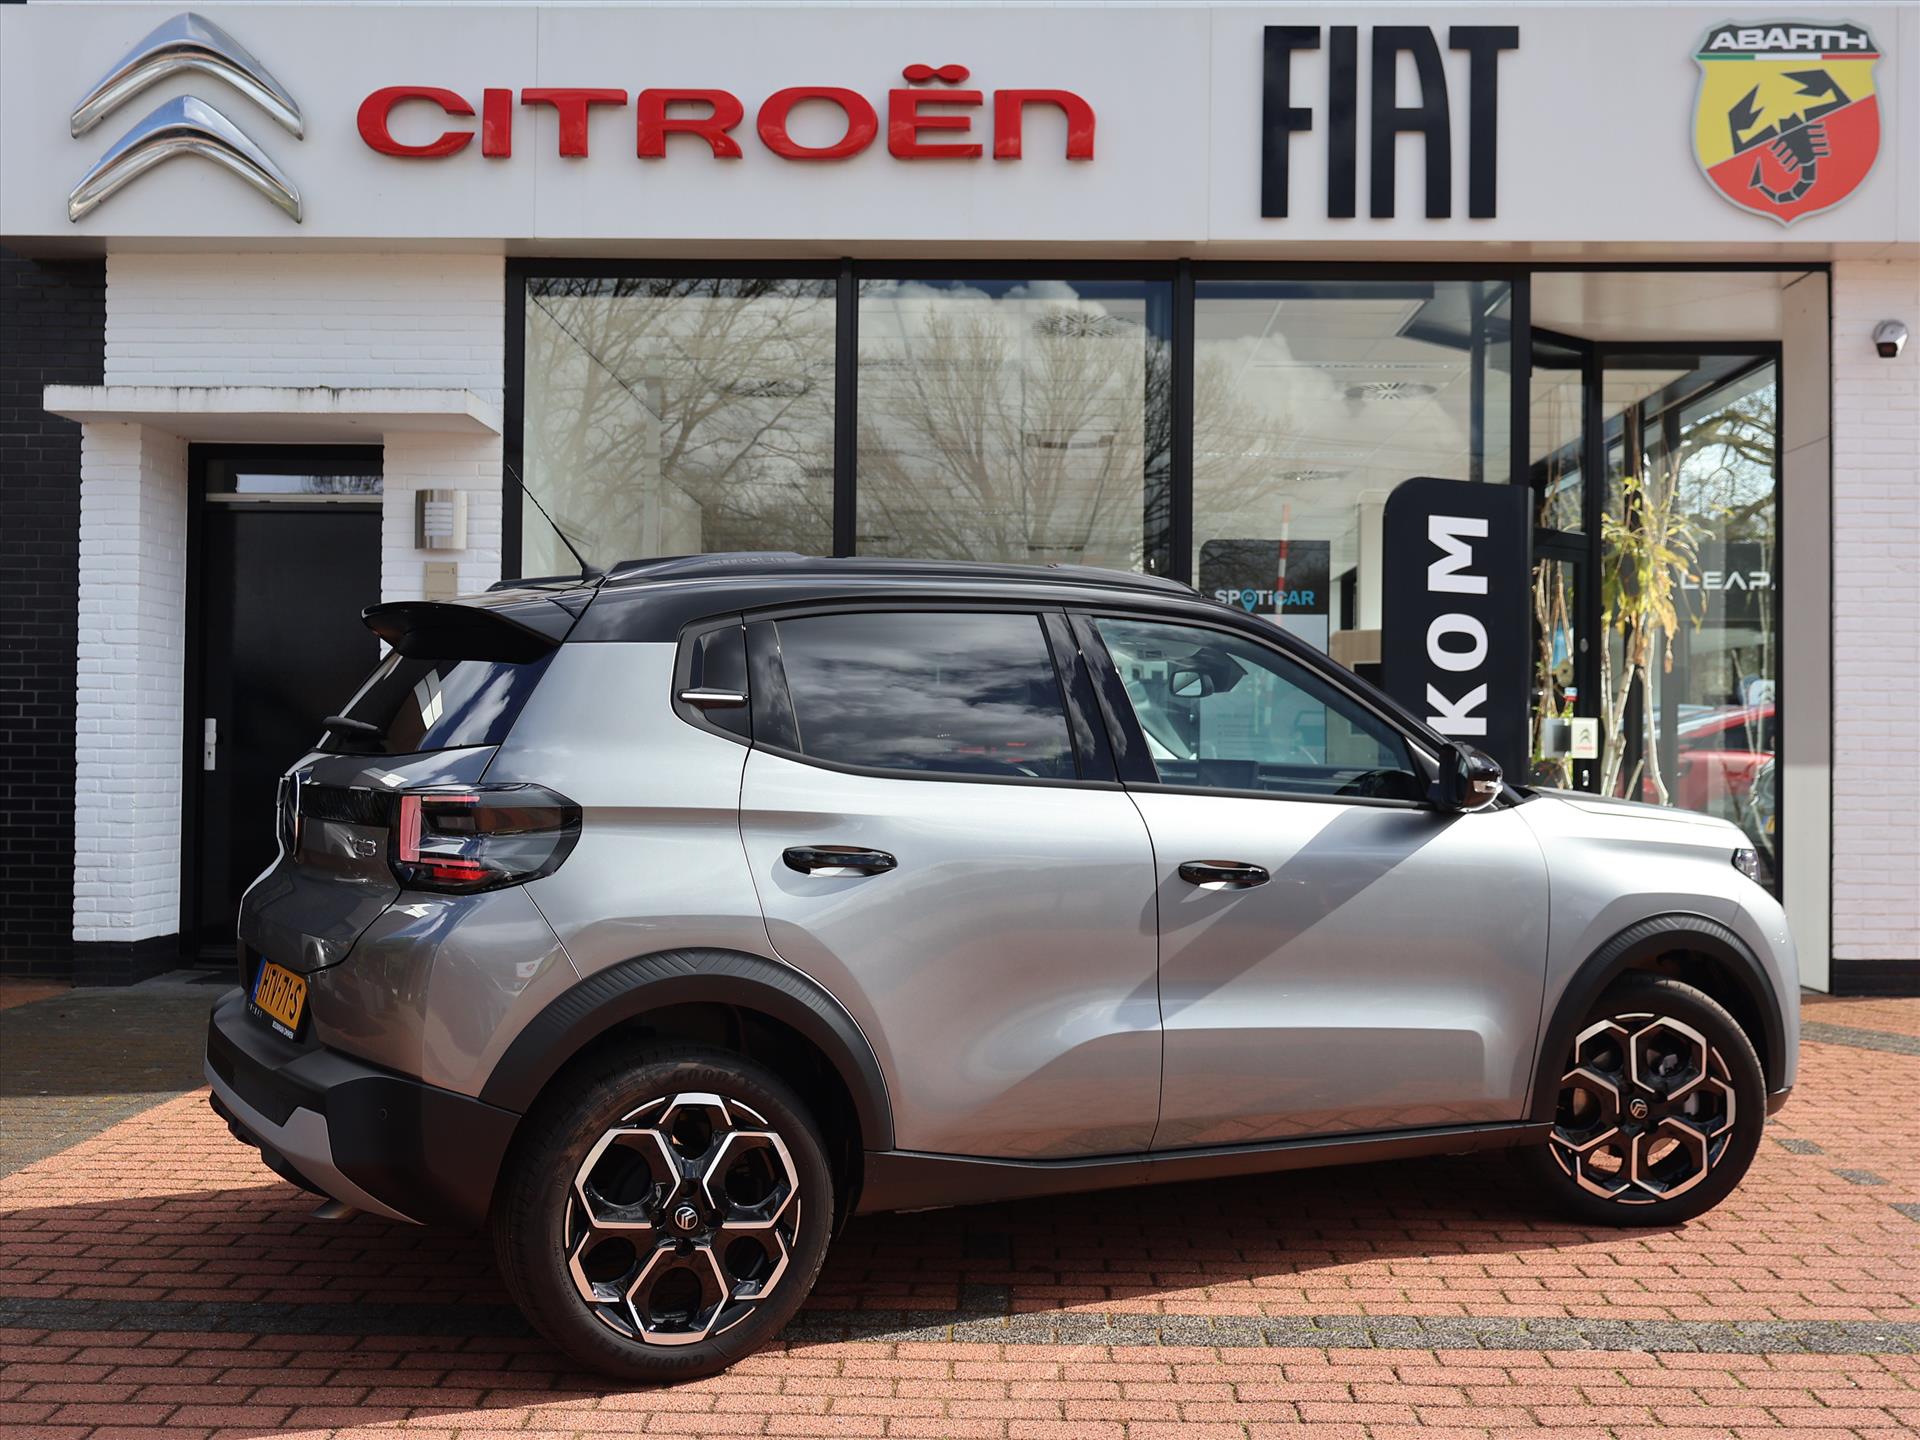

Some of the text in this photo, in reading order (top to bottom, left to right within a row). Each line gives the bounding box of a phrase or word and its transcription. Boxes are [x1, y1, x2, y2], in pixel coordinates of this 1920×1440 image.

[1709, 28, 1868, 50] ABARTH
[1261, 26, 1519, 218] FIAT
[1680, 571, 1776, 591] LEAP
